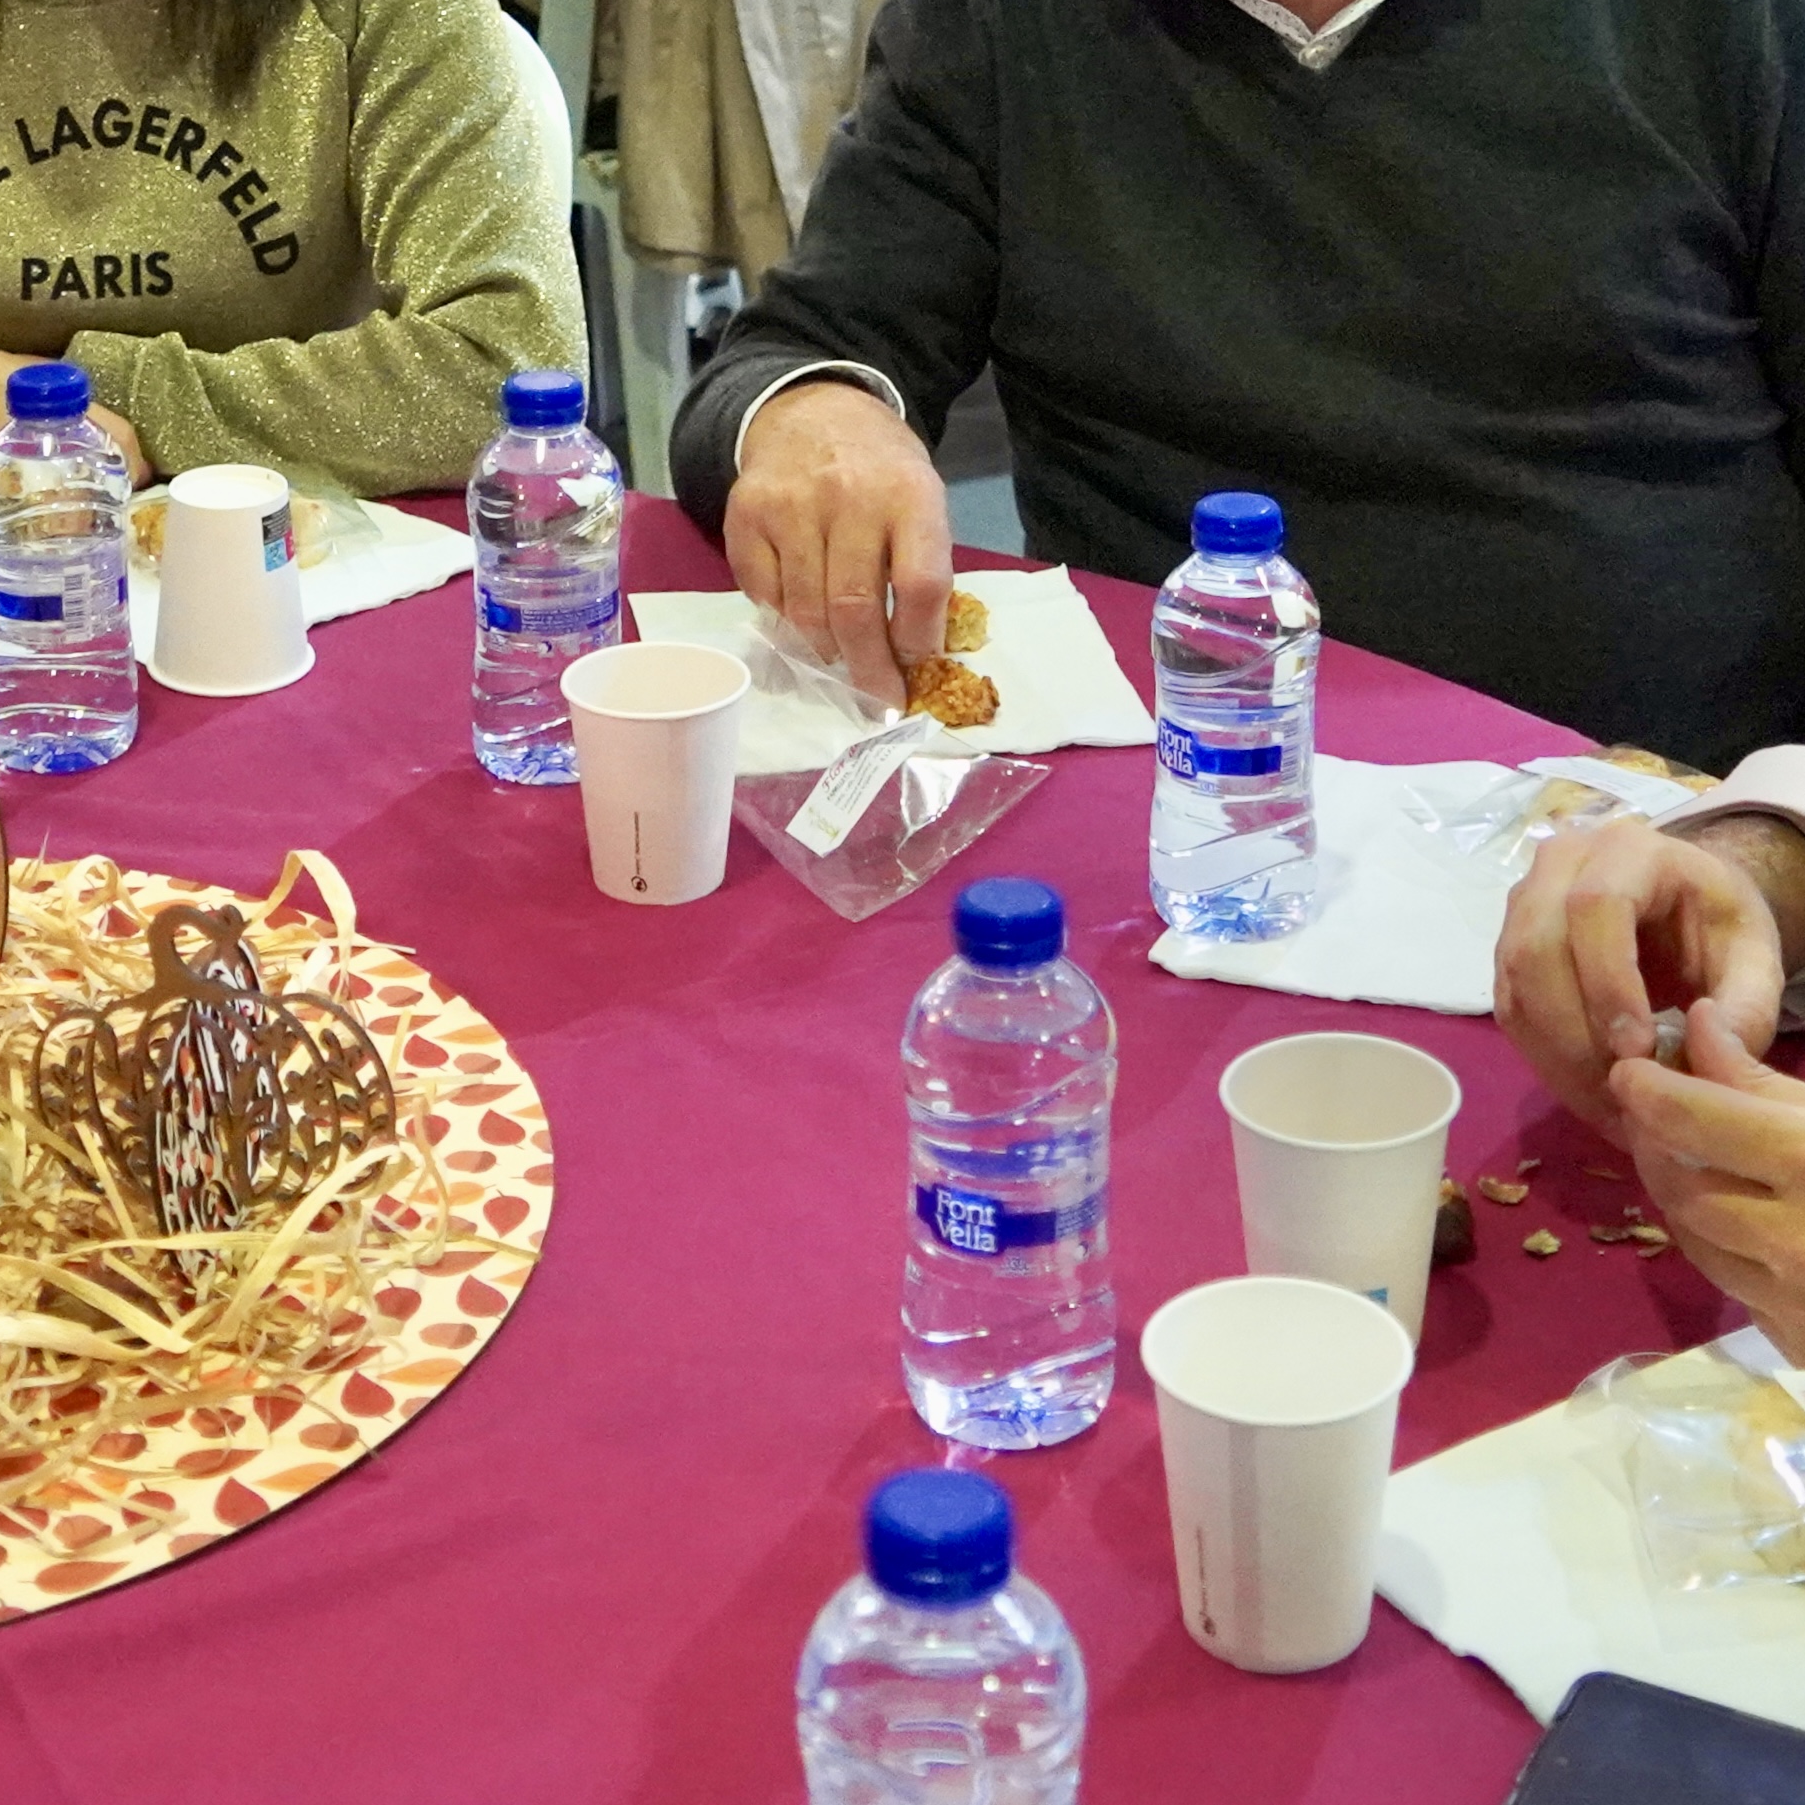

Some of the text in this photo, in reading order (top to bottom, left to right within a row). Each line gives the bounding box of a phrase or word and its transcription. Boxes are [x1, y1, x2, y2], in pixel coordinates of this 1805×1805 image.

[15, 98, 301, 276] LAGERFELD
[20, 250, 175, 301] PARIS
[1159, 740, 1194, 775] Vella
[936, 1188, 995, 1226] Font
[935, 1213, 996, 1253] Vella
